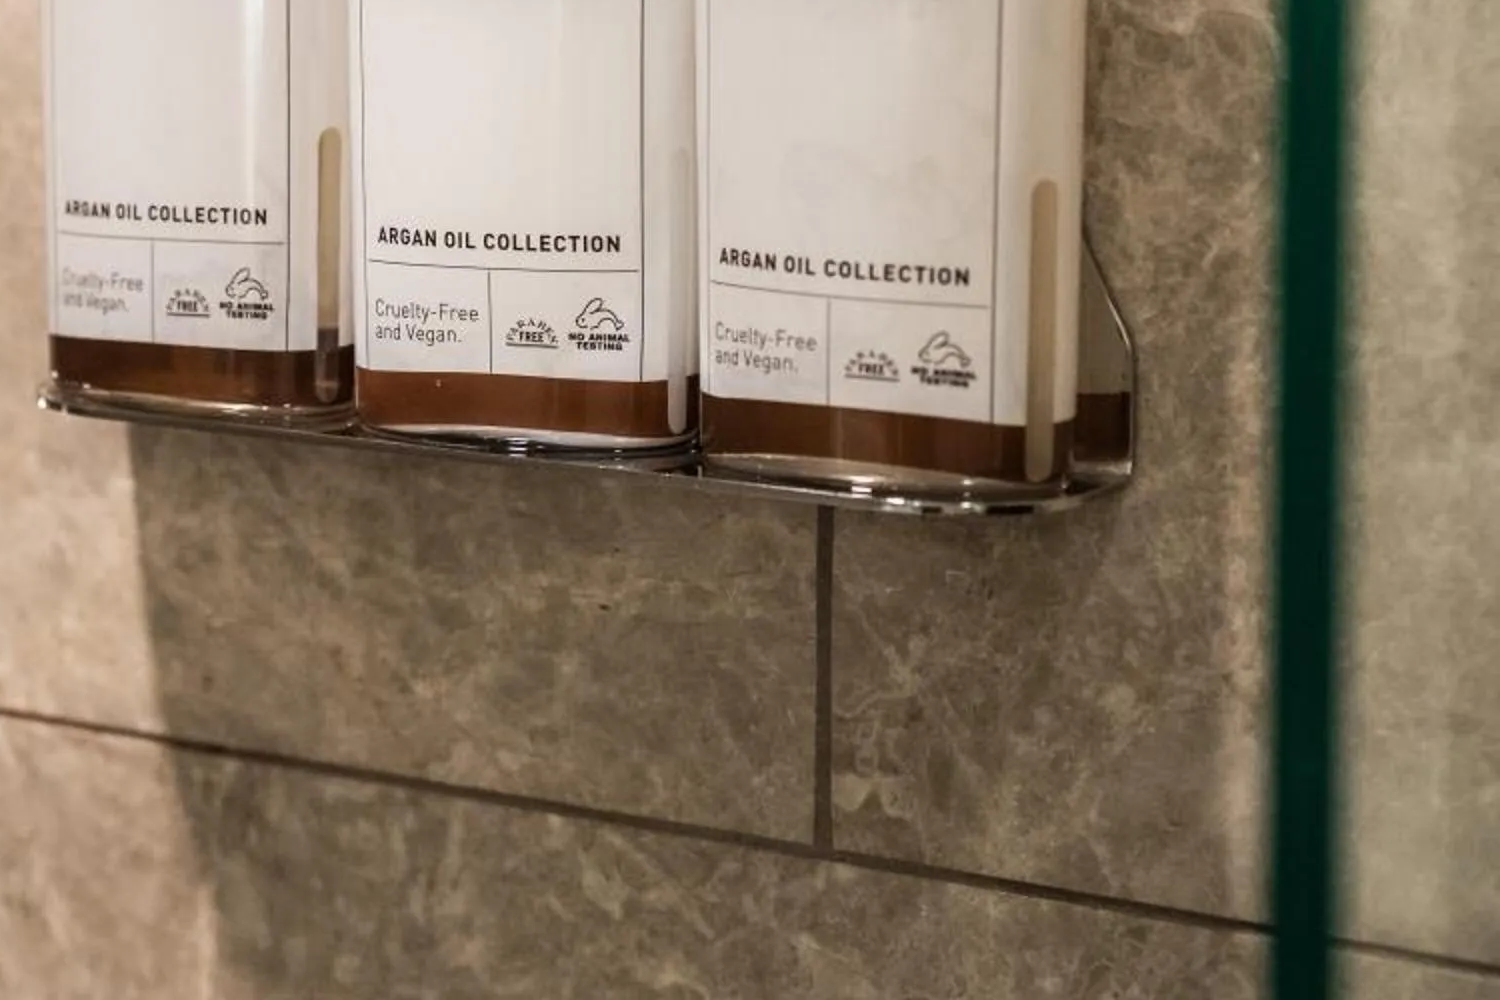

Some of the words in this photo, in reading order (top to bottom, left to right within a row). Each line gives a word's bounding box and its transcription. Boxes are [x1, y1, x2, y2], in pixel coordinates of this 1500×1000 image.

[65, 199, 111, 220] ARGAN
[115, 203, 143, 222] OIL
[149, 204, 268, 226] COLLECTION
[377, 226, 437, 248] ARGAN
[444, 231, 477, 250] OIL
[483, 232, 621, 253] COLLECTION
[719, 247, 777, 272] ARGAN
[783, 253, 816, 276] OIL
[823, 258, 970, 287] COLLECTION
[375, 297, 480, 324] Cruelty-Free
[375, 322, 402, 342] and
[405, 325, 462, 347] Vegan.
[519, 331, 545, 343] FREE
[568, 332, 585, 341] NO
[588, 333, 630, 342] ANIMAL
[576, 341, 623, 351] TESTING
[715, 321, 818, 351] Cruelty-Free
[715, 347, 739, 367] and
[742, 350, 799, 374] Vegan.
